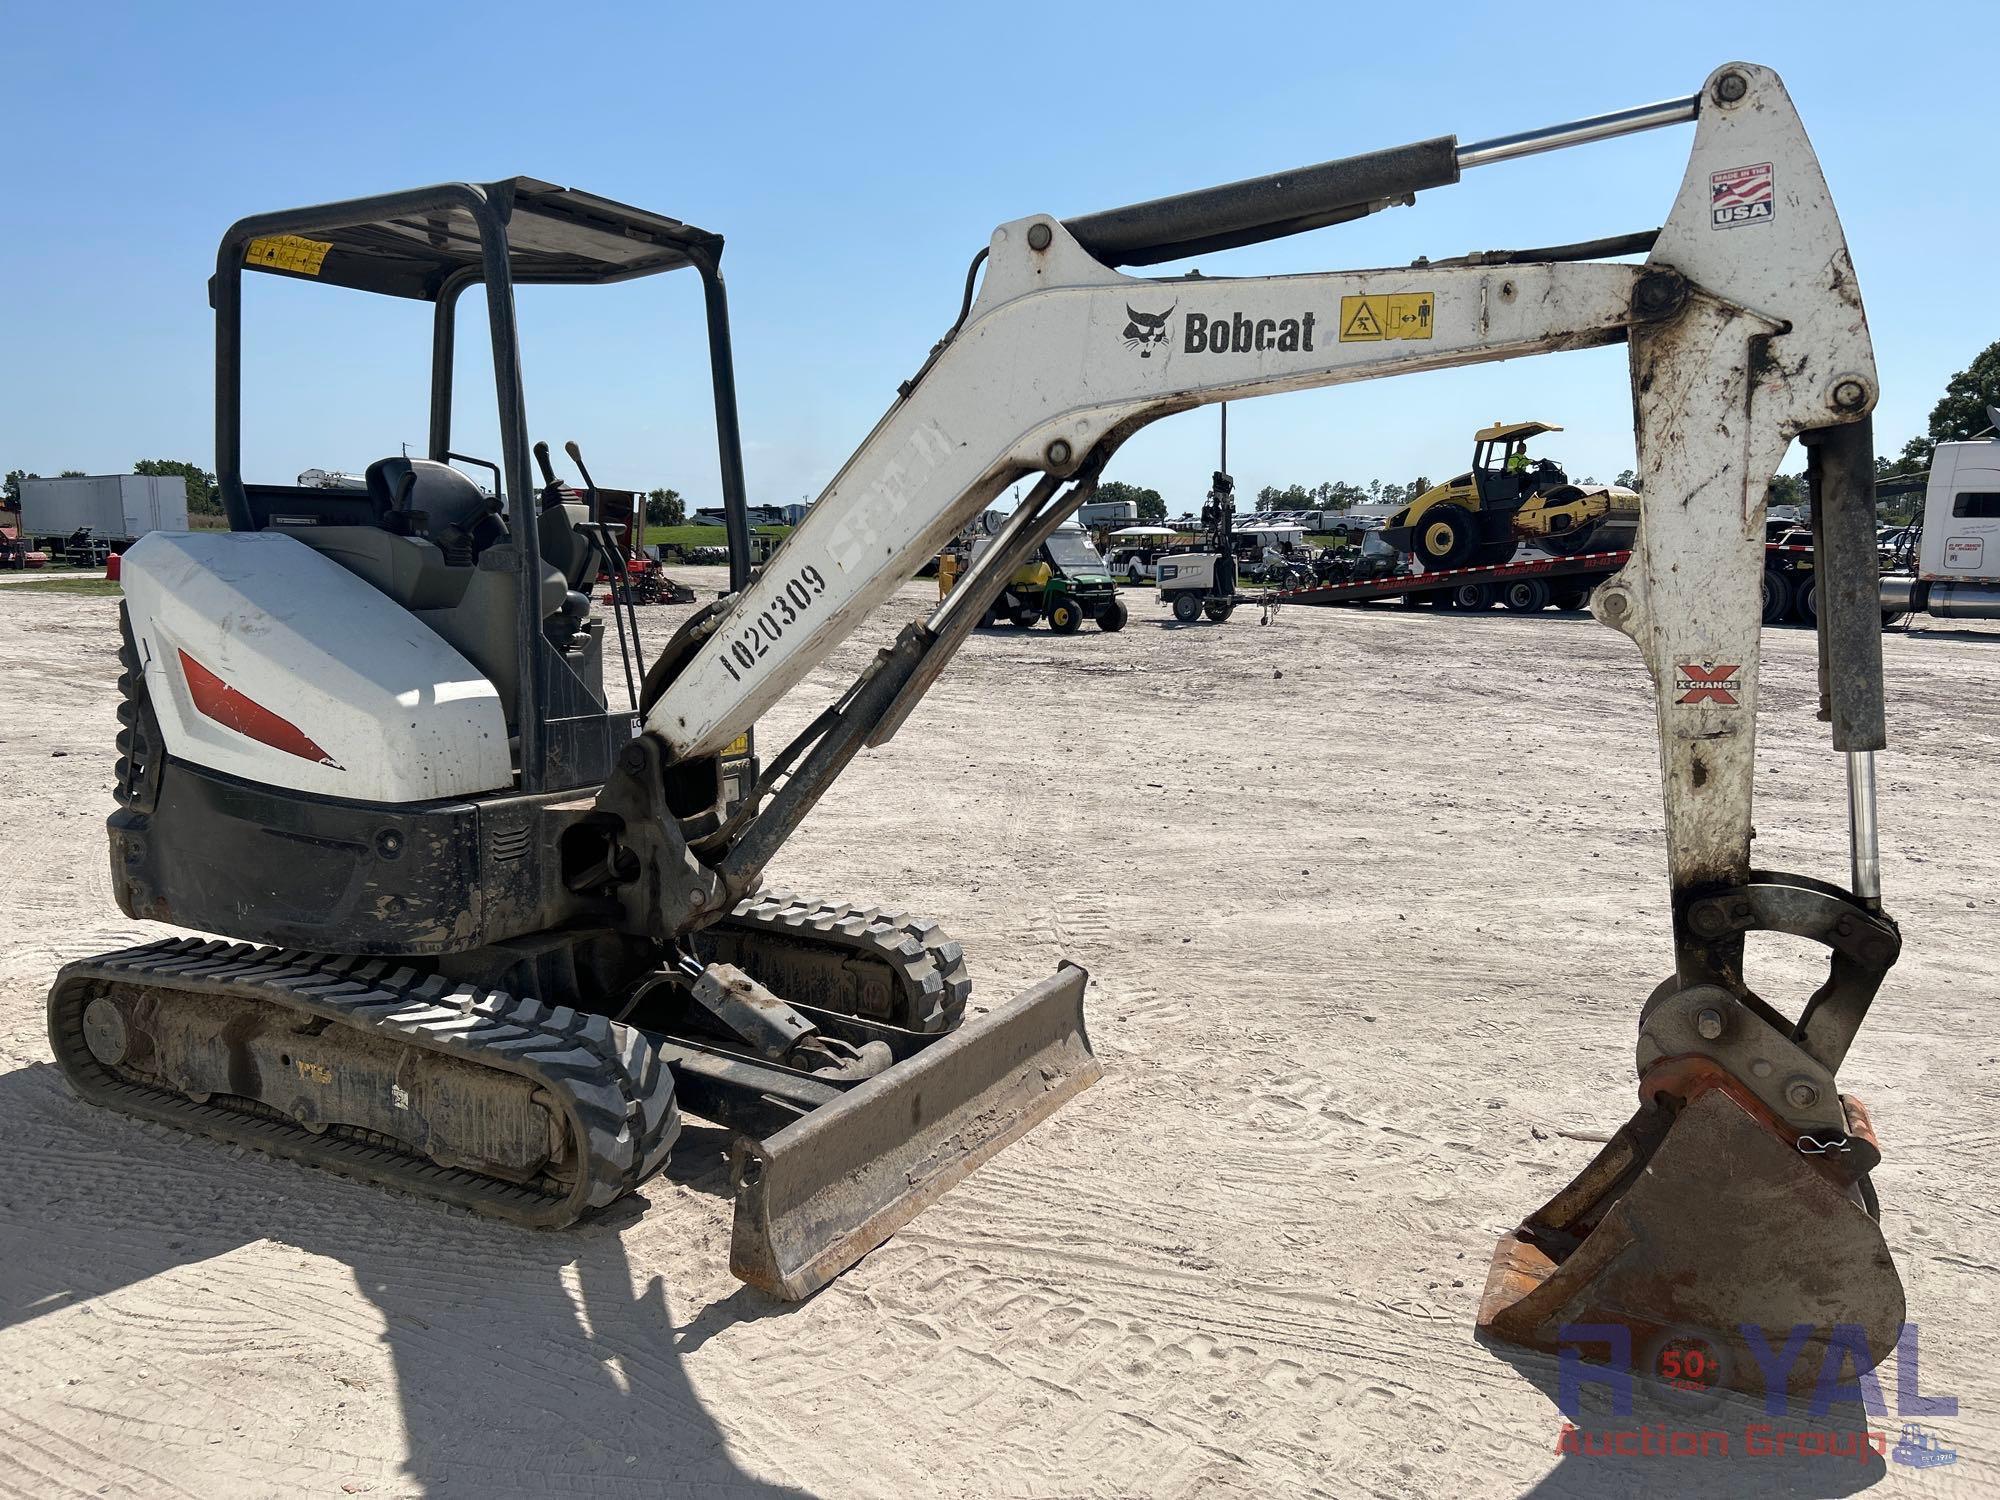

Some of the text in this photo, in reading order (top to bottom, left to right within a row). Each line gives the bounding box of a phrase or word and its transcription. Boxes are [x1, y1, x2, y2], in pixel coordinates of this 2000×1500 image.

[1714, 172, 1738, 182] MADE
[1752, 167, 1767, 175] THE
[1716, 203, 1768, 222] USA
[1184, 312, 1315, 353] Bobcat
[719, 565, 825, 682] 1020309
[1677, 681, 1738, 689] X-CHANGE
